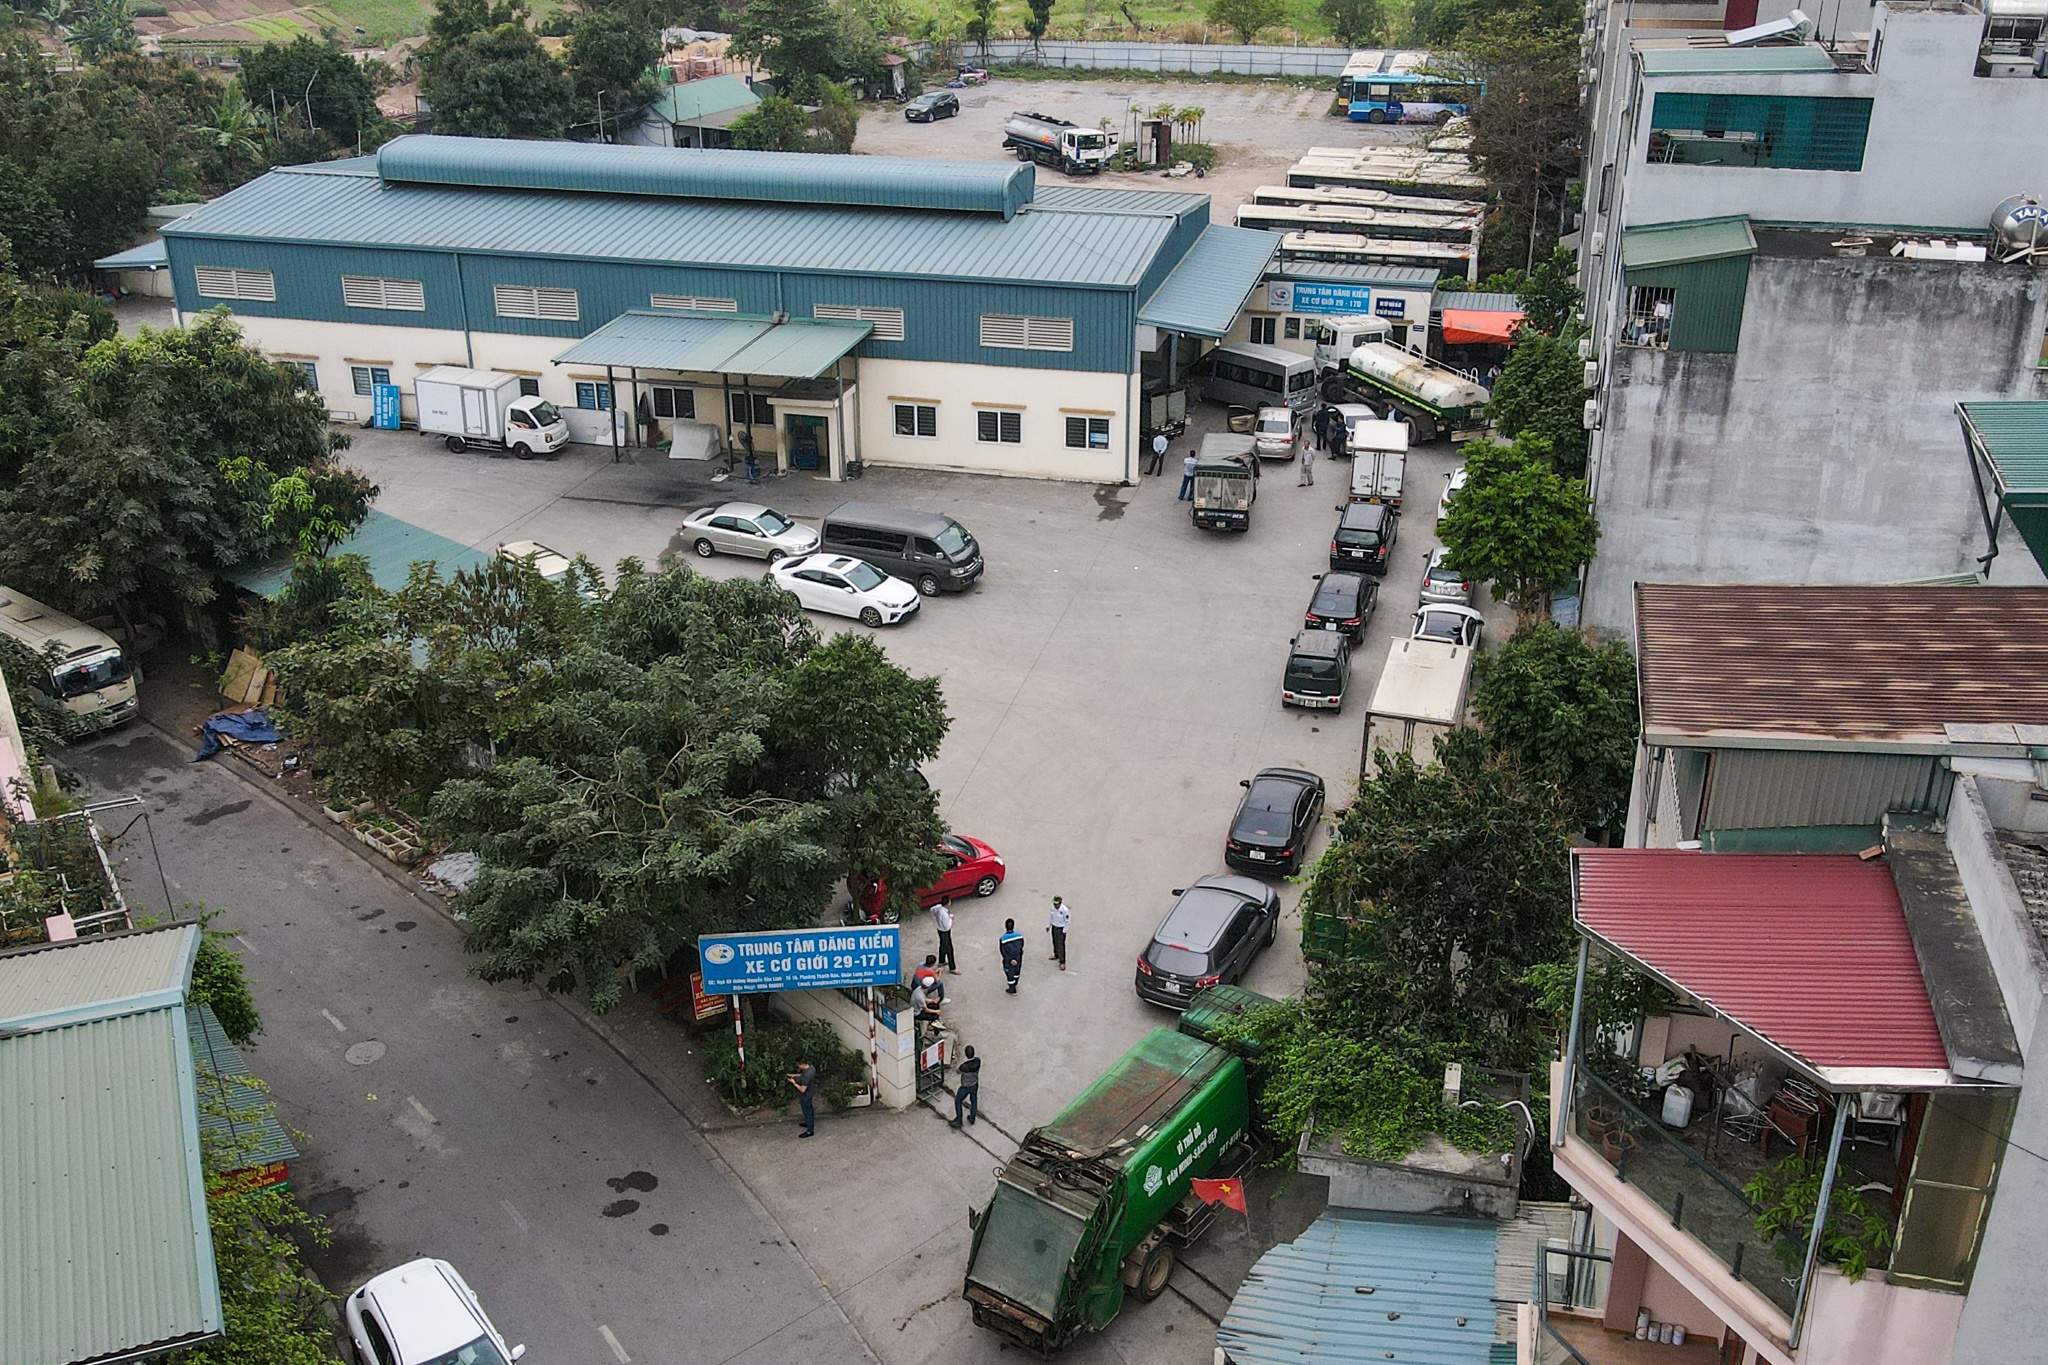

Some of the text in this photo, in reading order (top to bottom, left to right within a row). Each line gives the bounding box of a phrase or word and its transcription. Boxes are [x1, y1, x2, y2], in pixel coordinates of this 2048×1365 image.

[737, 930, 894, 957] TRUNG TÂM ĐĂNG KIỂM
[745, 952, 889, 974] XE CƠ GIỚI 29-17D
